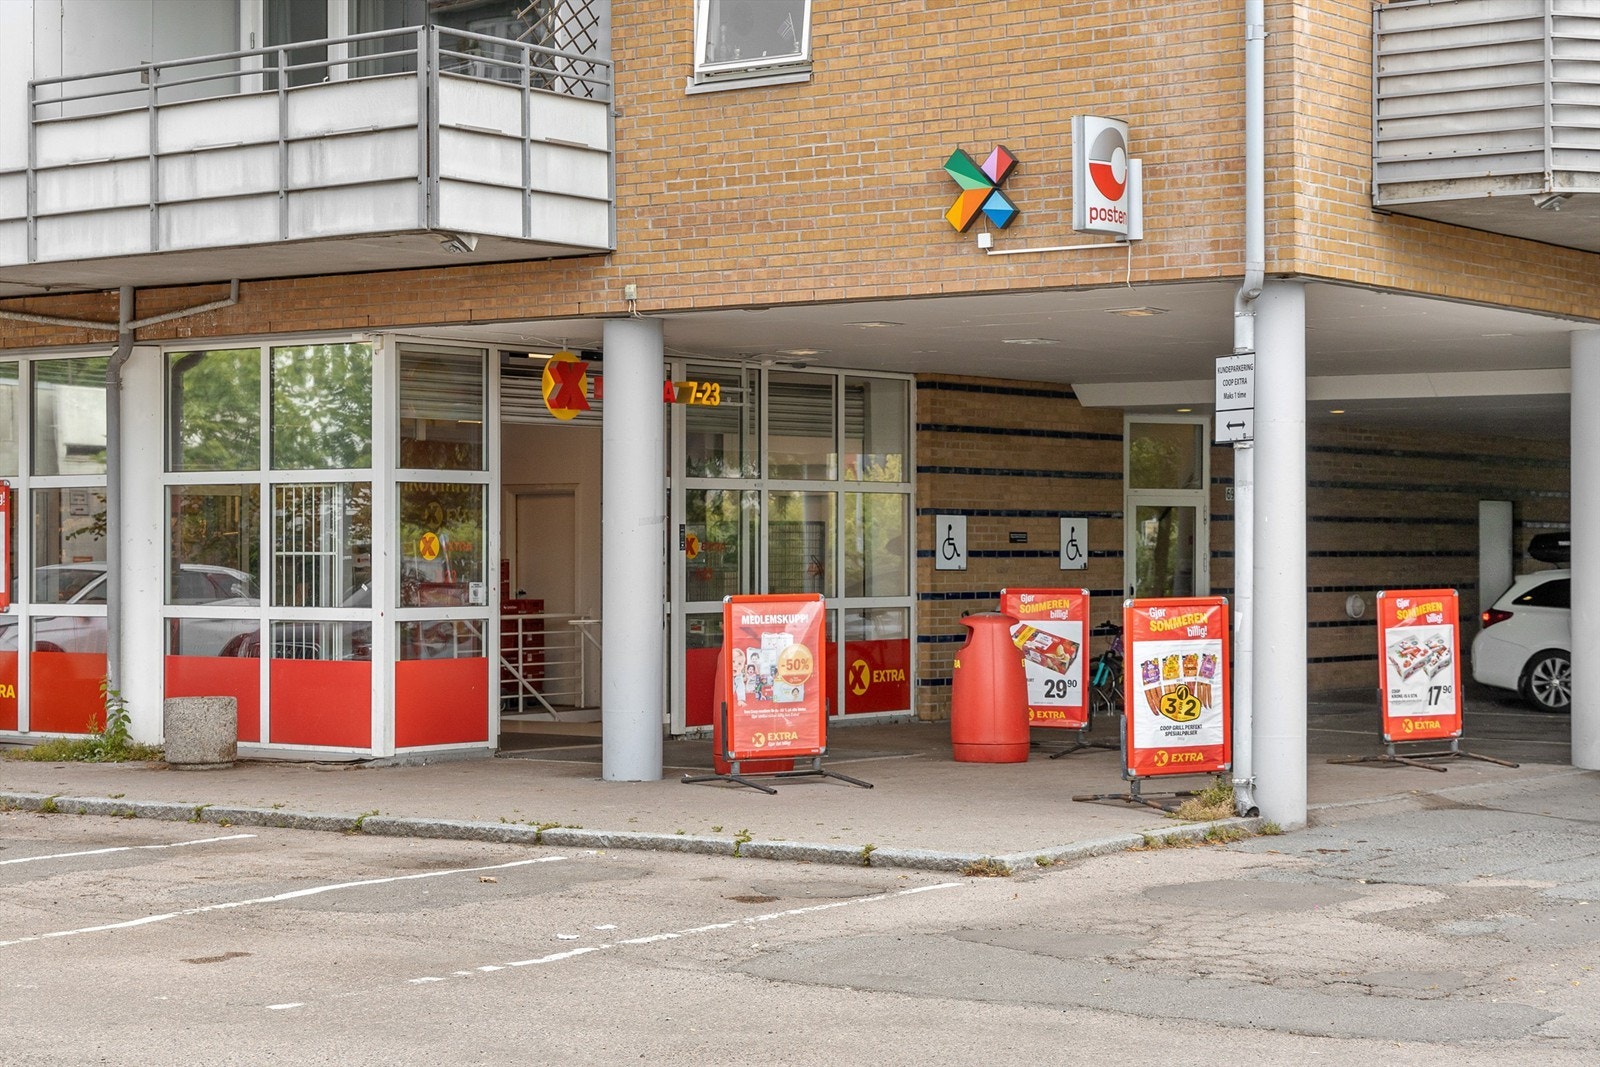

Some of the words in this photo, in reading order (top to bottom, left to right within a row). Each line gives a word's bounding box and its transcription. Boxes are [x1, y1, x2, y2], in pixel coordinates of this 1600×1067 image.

[1217, 363, 1253, 374] KUNDEPARKERING
[1222, 378, 1234, 387] COOP
[1234, 377, 1248, 386] EXTRA
[689, 381, 720, 406] 7-23
[1223, 392, 1234, 400] Maks
[1237, 391, 1247, 399] time
[1020, 594, 1035, 604] Gjør
[1019, 599, 1070, 614] SOMMEREN
[1396, 602, 1443, 620] SOMMEREN
[741, 613, 809, 625] MEDLEMSKUPP!
[1050, 609, 1069, 620] billig!
[1149, 607, 1167, 620] Gjør
[1149, 612, 1209, 632] SOMMEREN
[1186, 625, 1208, 638] billig!
[781, 658, 810, 671] -50%
[873, 668, 906, 683] EXTRA
[1036, 710, 1066, 719] EXTRA
[1414, 721, 1441, 730] EXTRA
[767, 731, 798, 741] EXTRA
[1171, 752, 1204, 763] EXTRA
